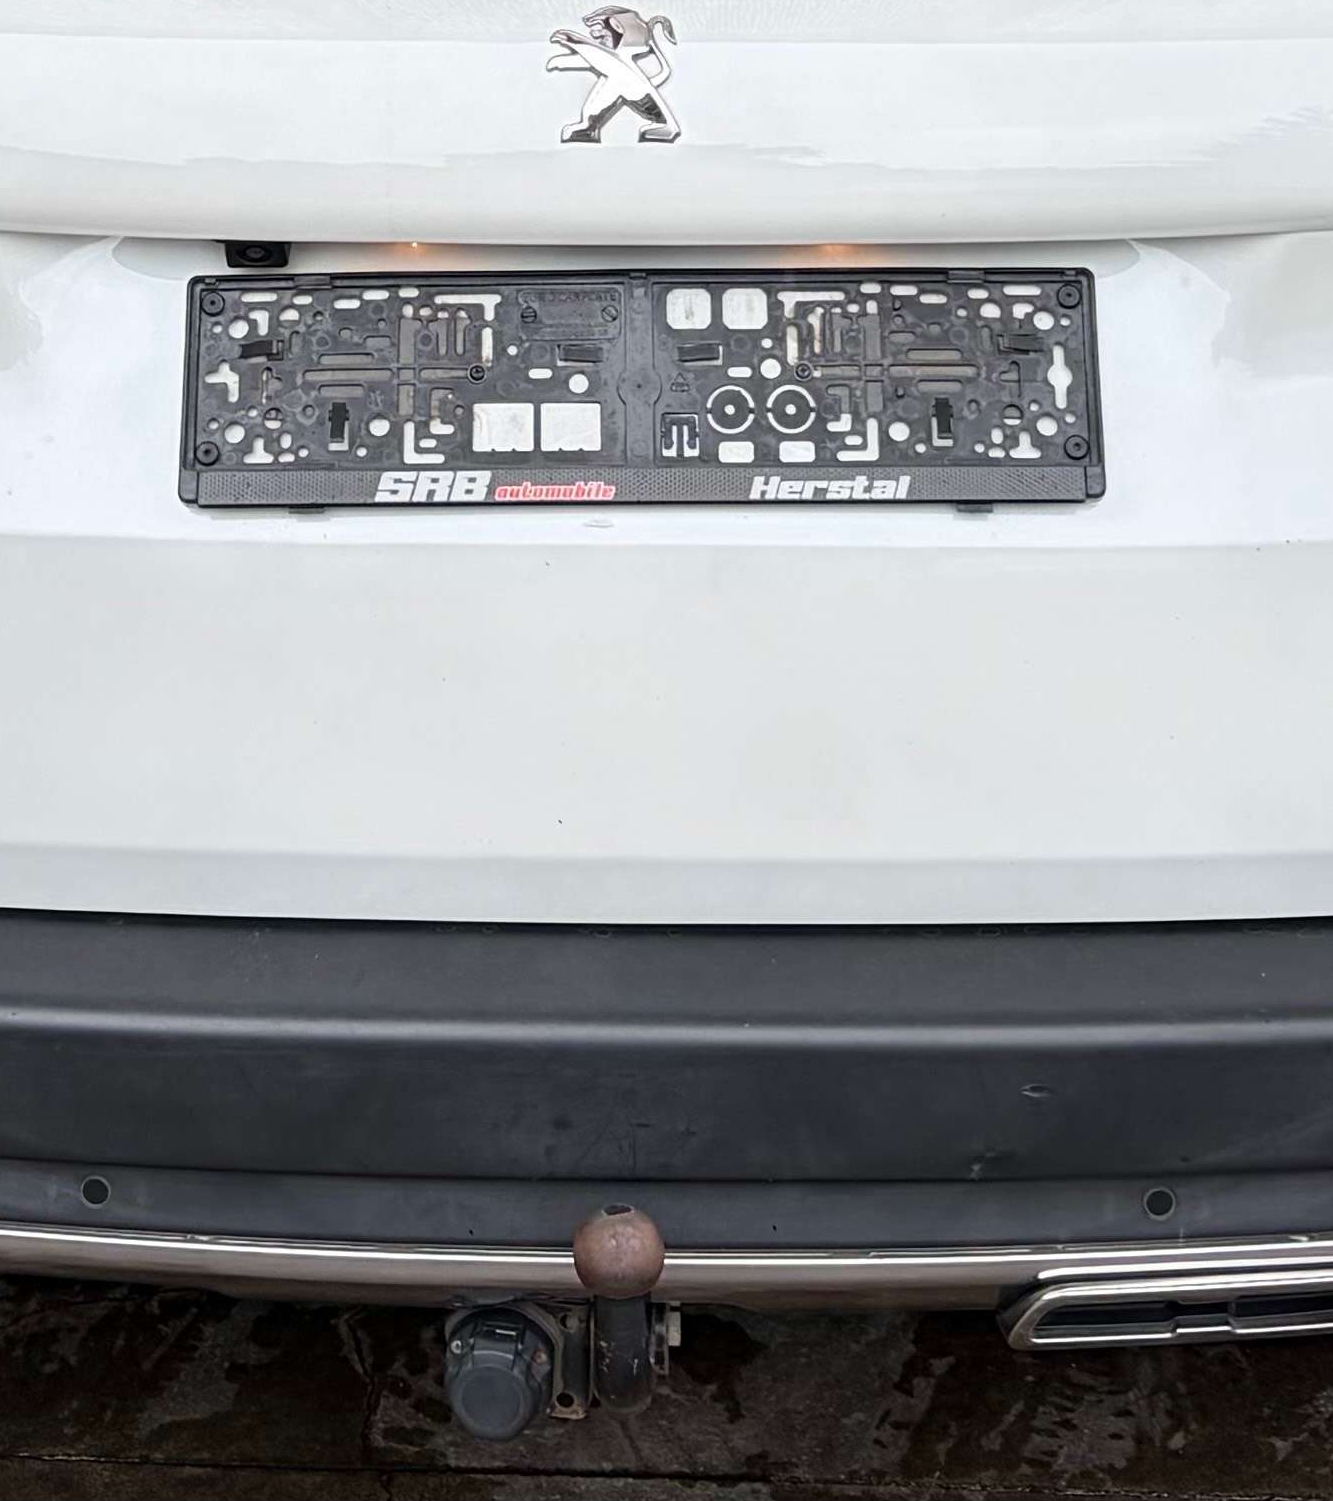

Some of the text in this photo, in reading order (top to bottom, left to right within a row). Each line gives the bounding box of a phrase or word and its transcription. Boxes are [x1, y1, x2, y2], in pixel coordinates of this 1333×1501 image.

[374, 470, 616, 502] SRB automobile
[749, 475, 911, 500] Herstal
